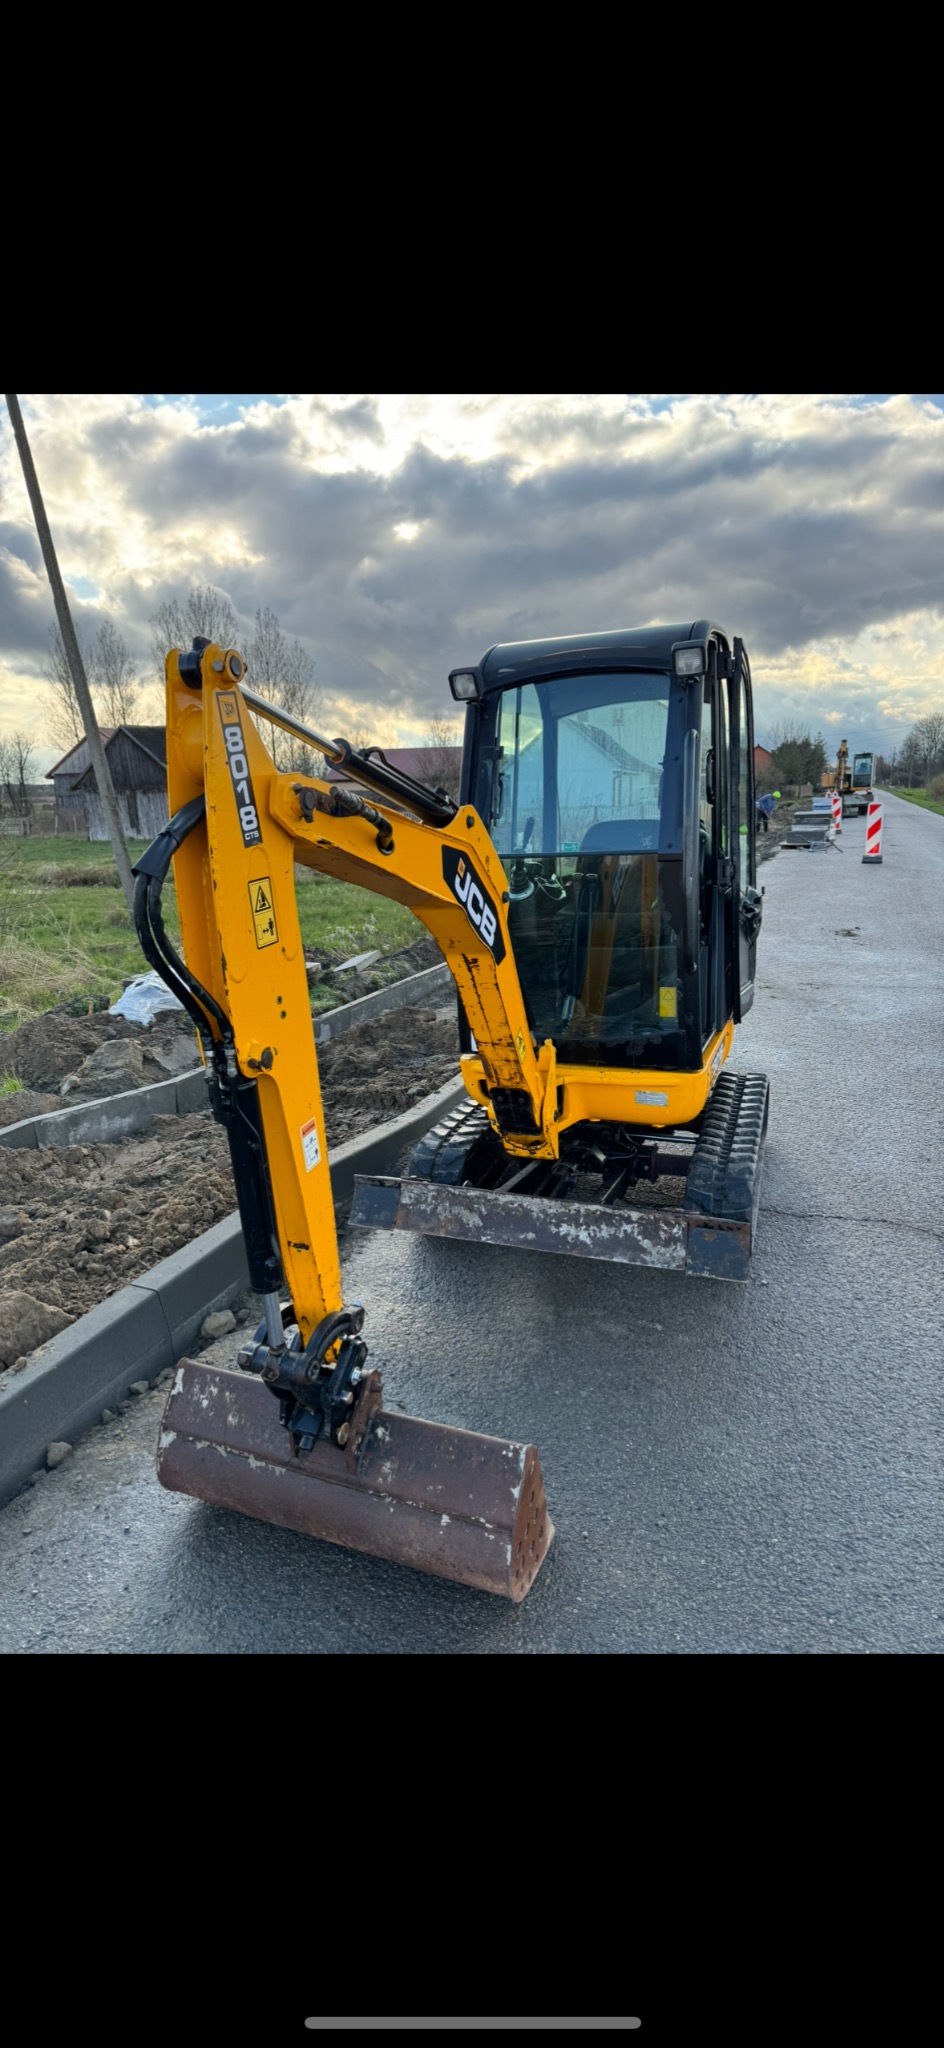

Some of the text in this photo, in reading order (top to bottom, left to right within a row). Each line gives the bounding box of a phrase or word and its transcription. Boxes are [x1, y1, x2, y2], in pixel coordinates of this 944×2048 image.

[225, 726, 258, 831] 8018
[244, 830, 260, 840] CTS
[454, 872, 497, 947] JCB
